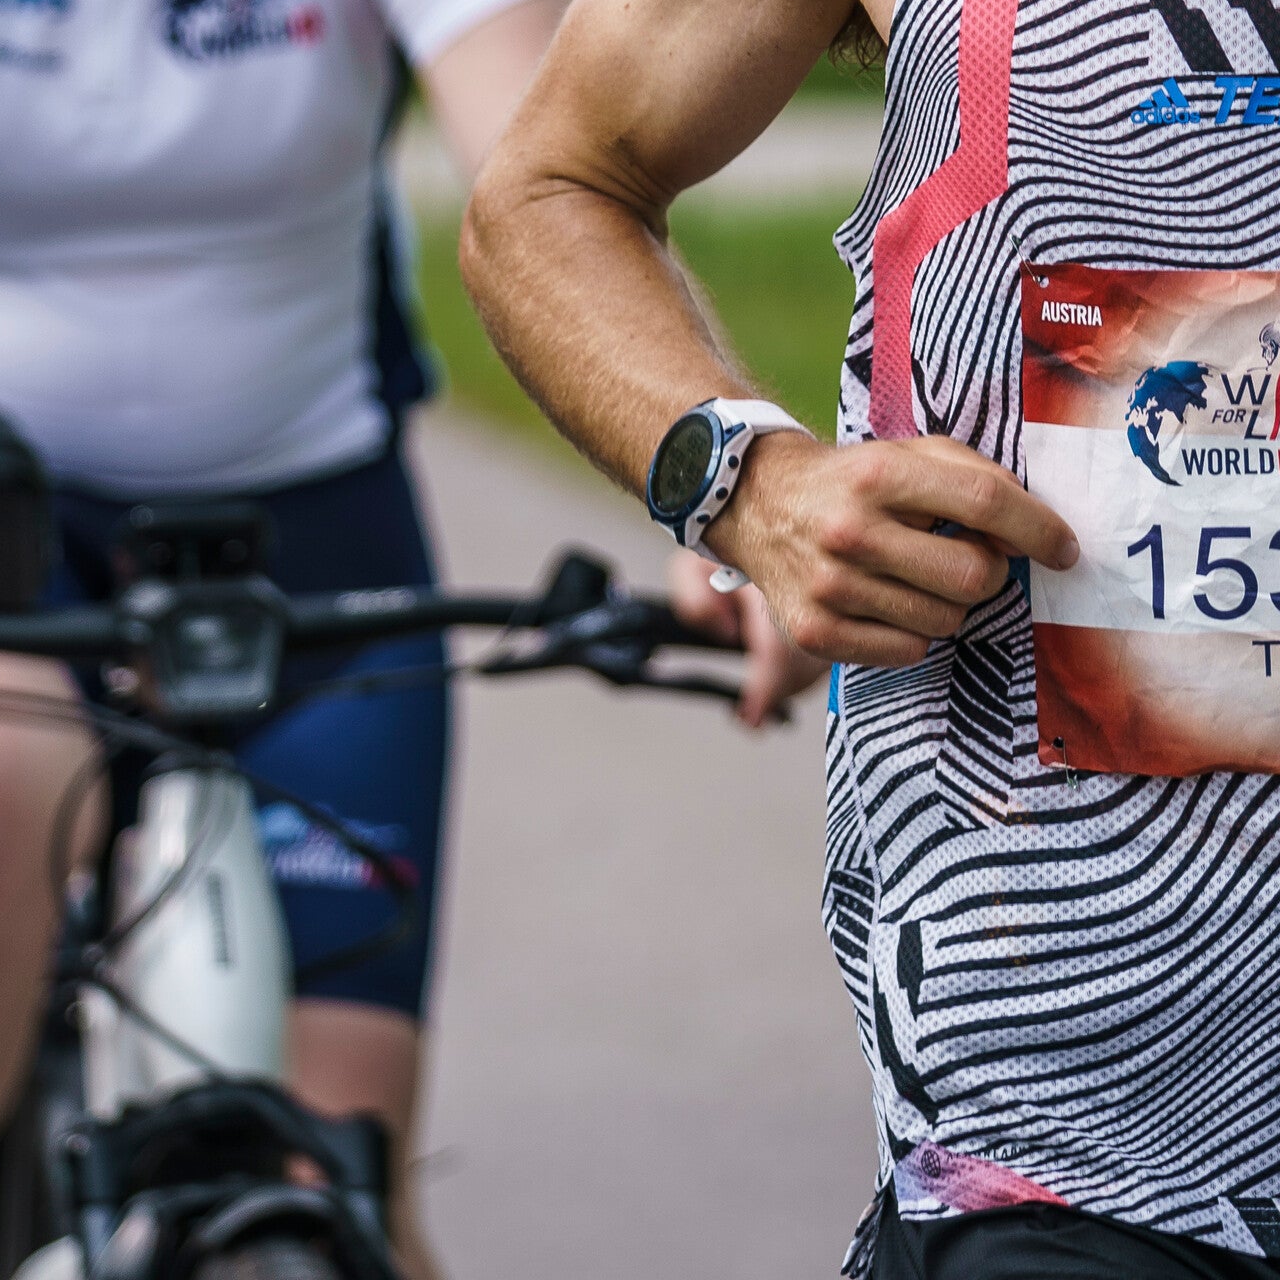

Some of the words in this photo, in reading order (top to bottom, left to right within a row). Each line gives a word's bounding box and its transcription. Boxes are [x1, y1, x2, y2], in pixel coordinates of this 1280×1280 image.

[1131, 107, 1200, 125] adidas
[1041, 300, 1103, 327] AUSTRIA
[1211, 409, 1246, 424] FOR
